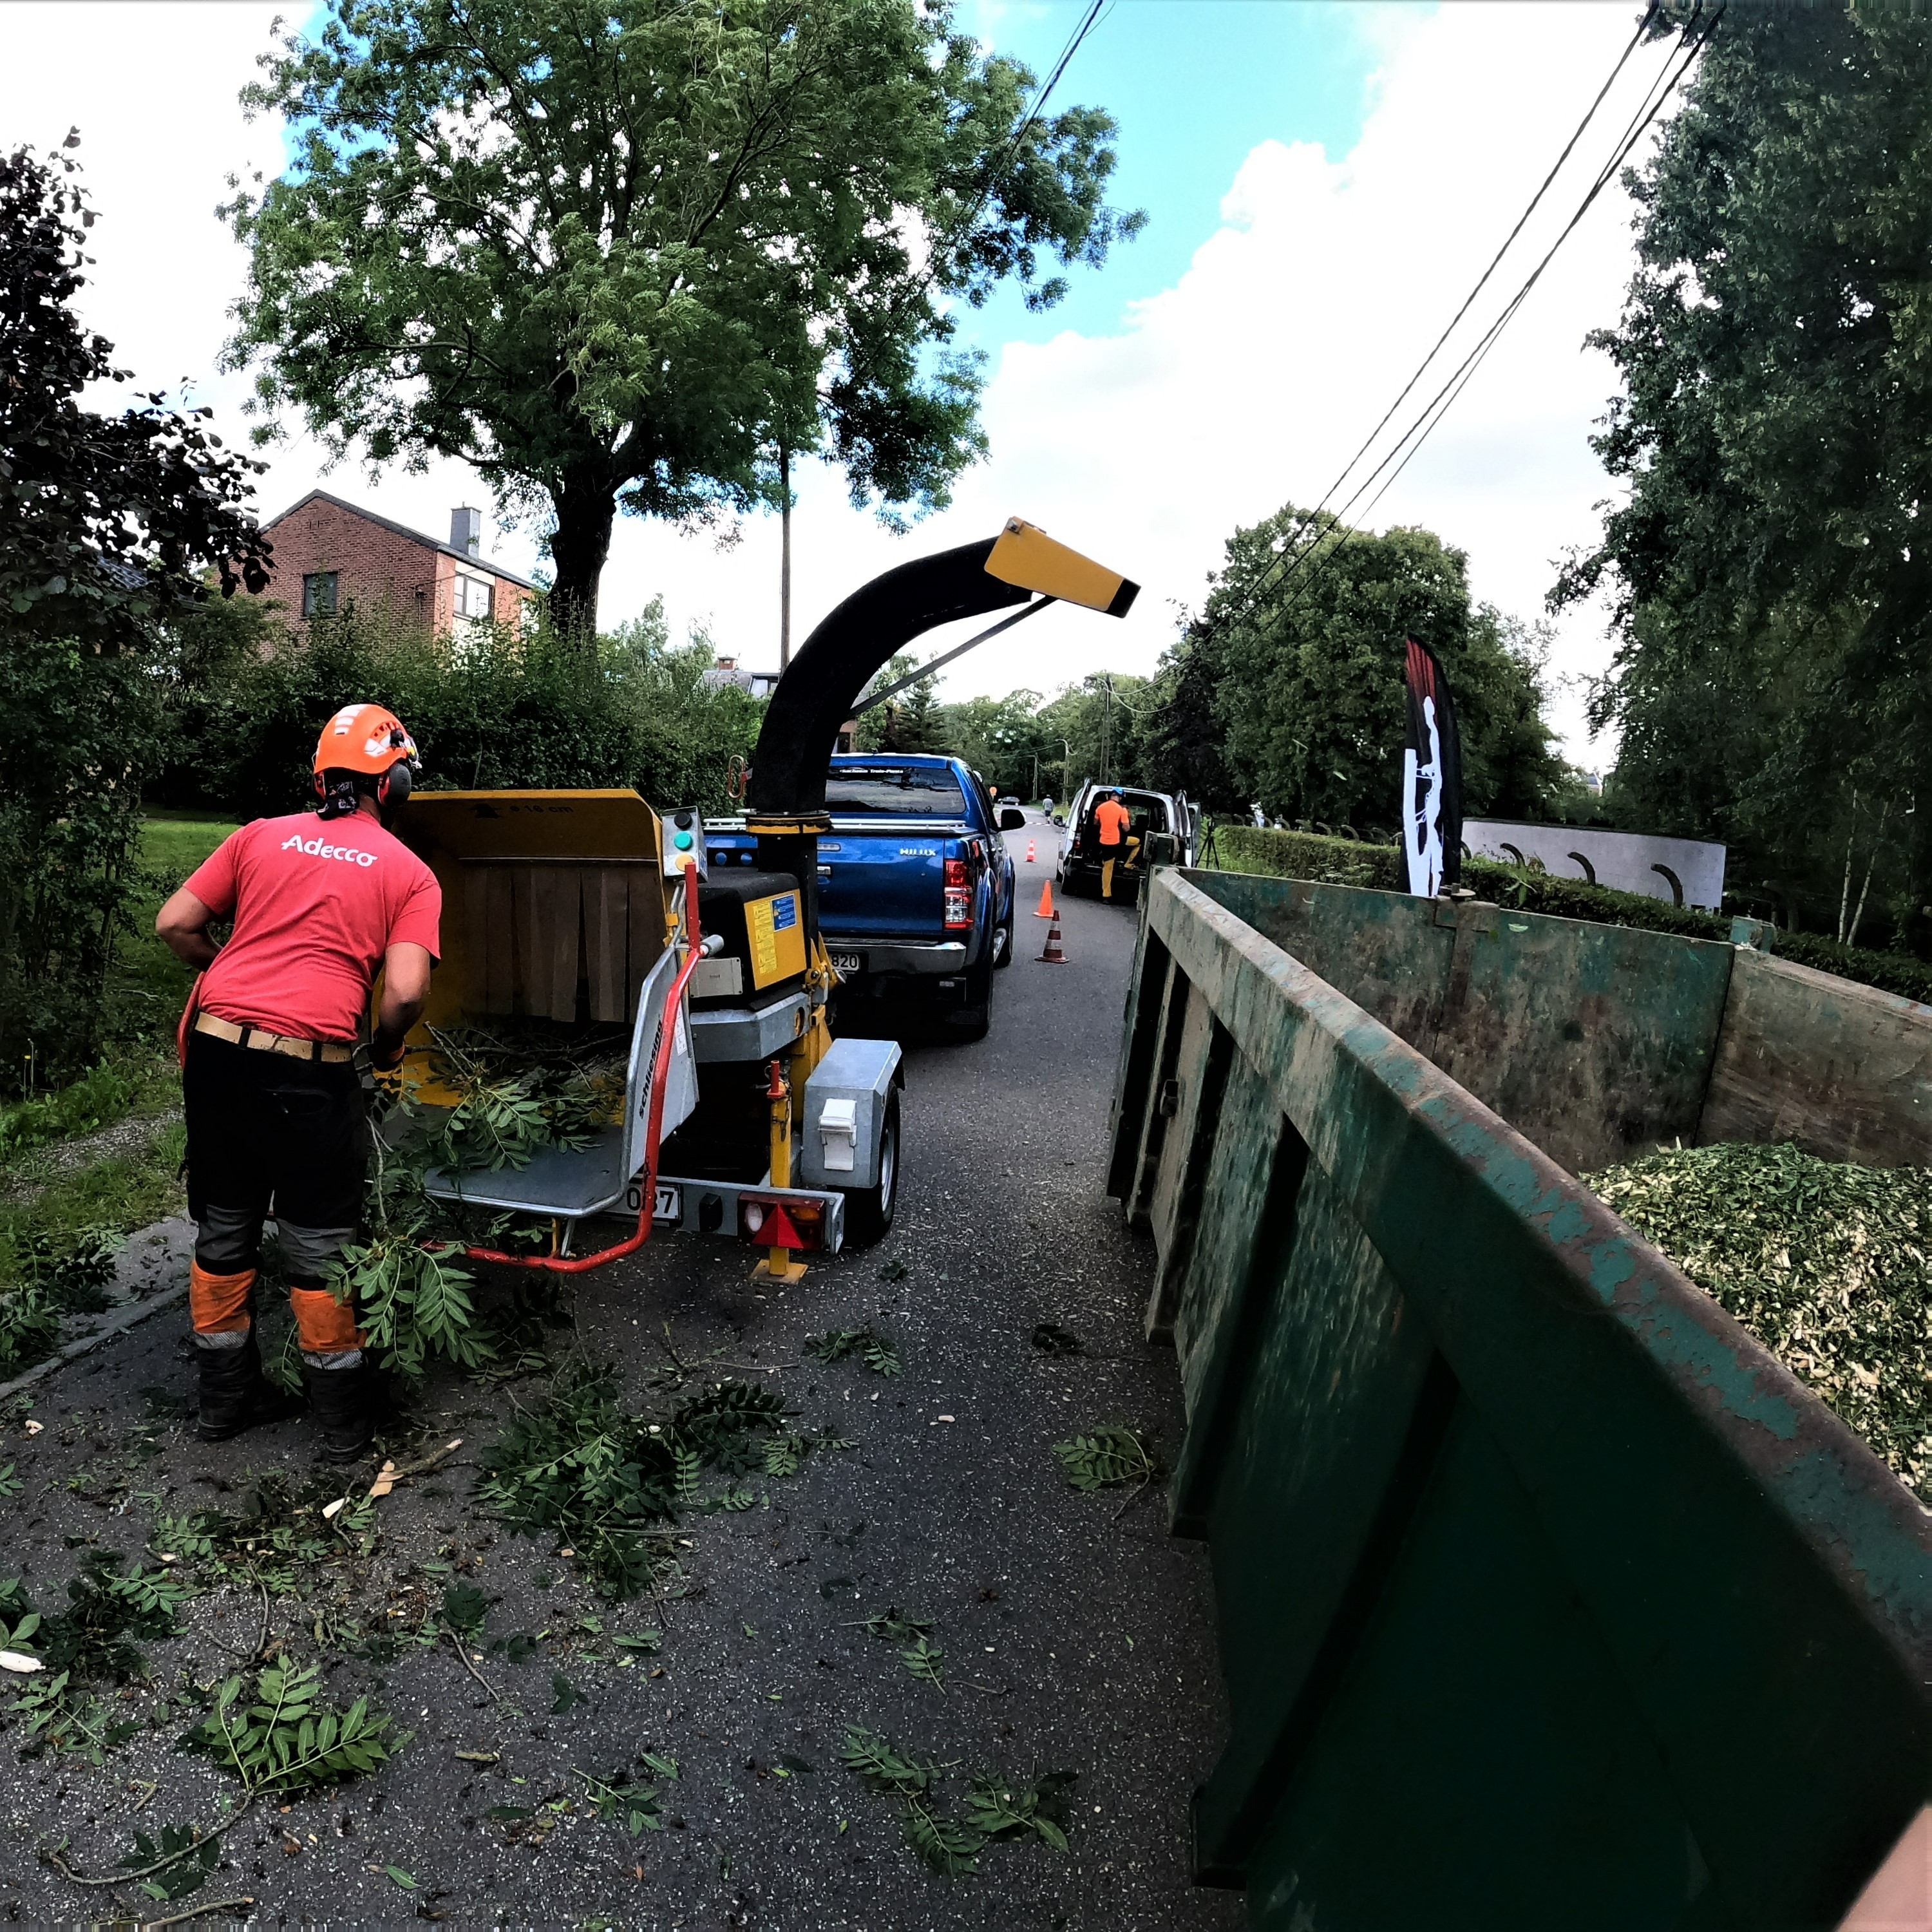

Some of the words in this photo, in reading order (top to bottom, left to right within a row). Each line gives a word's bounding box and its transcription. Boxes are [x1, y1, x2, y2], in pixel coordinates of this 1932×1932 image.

[281, 835, 379, 867] Adecco
[900, 848, 936, 857] HILUX
[831, 955, 857, 969] 820
[627, 1187, 674, 1214] 07
